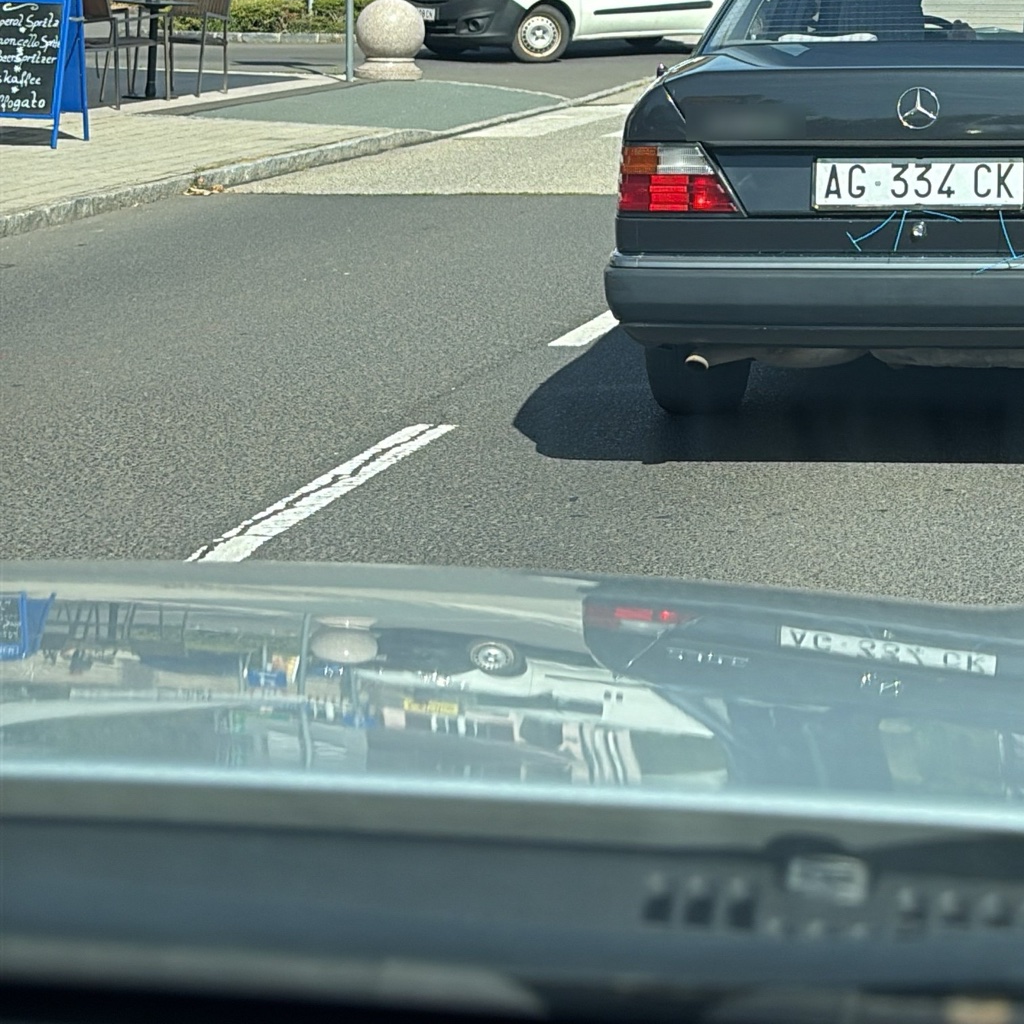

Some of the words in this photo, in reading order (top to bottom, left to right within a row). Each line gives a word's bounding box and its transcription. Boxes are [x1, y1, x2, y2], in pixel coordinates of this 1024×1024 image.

[824, 163, 867, 199] AG
[890, 163, 956, 198] 334
[973, 163, 1015, 198] CK
